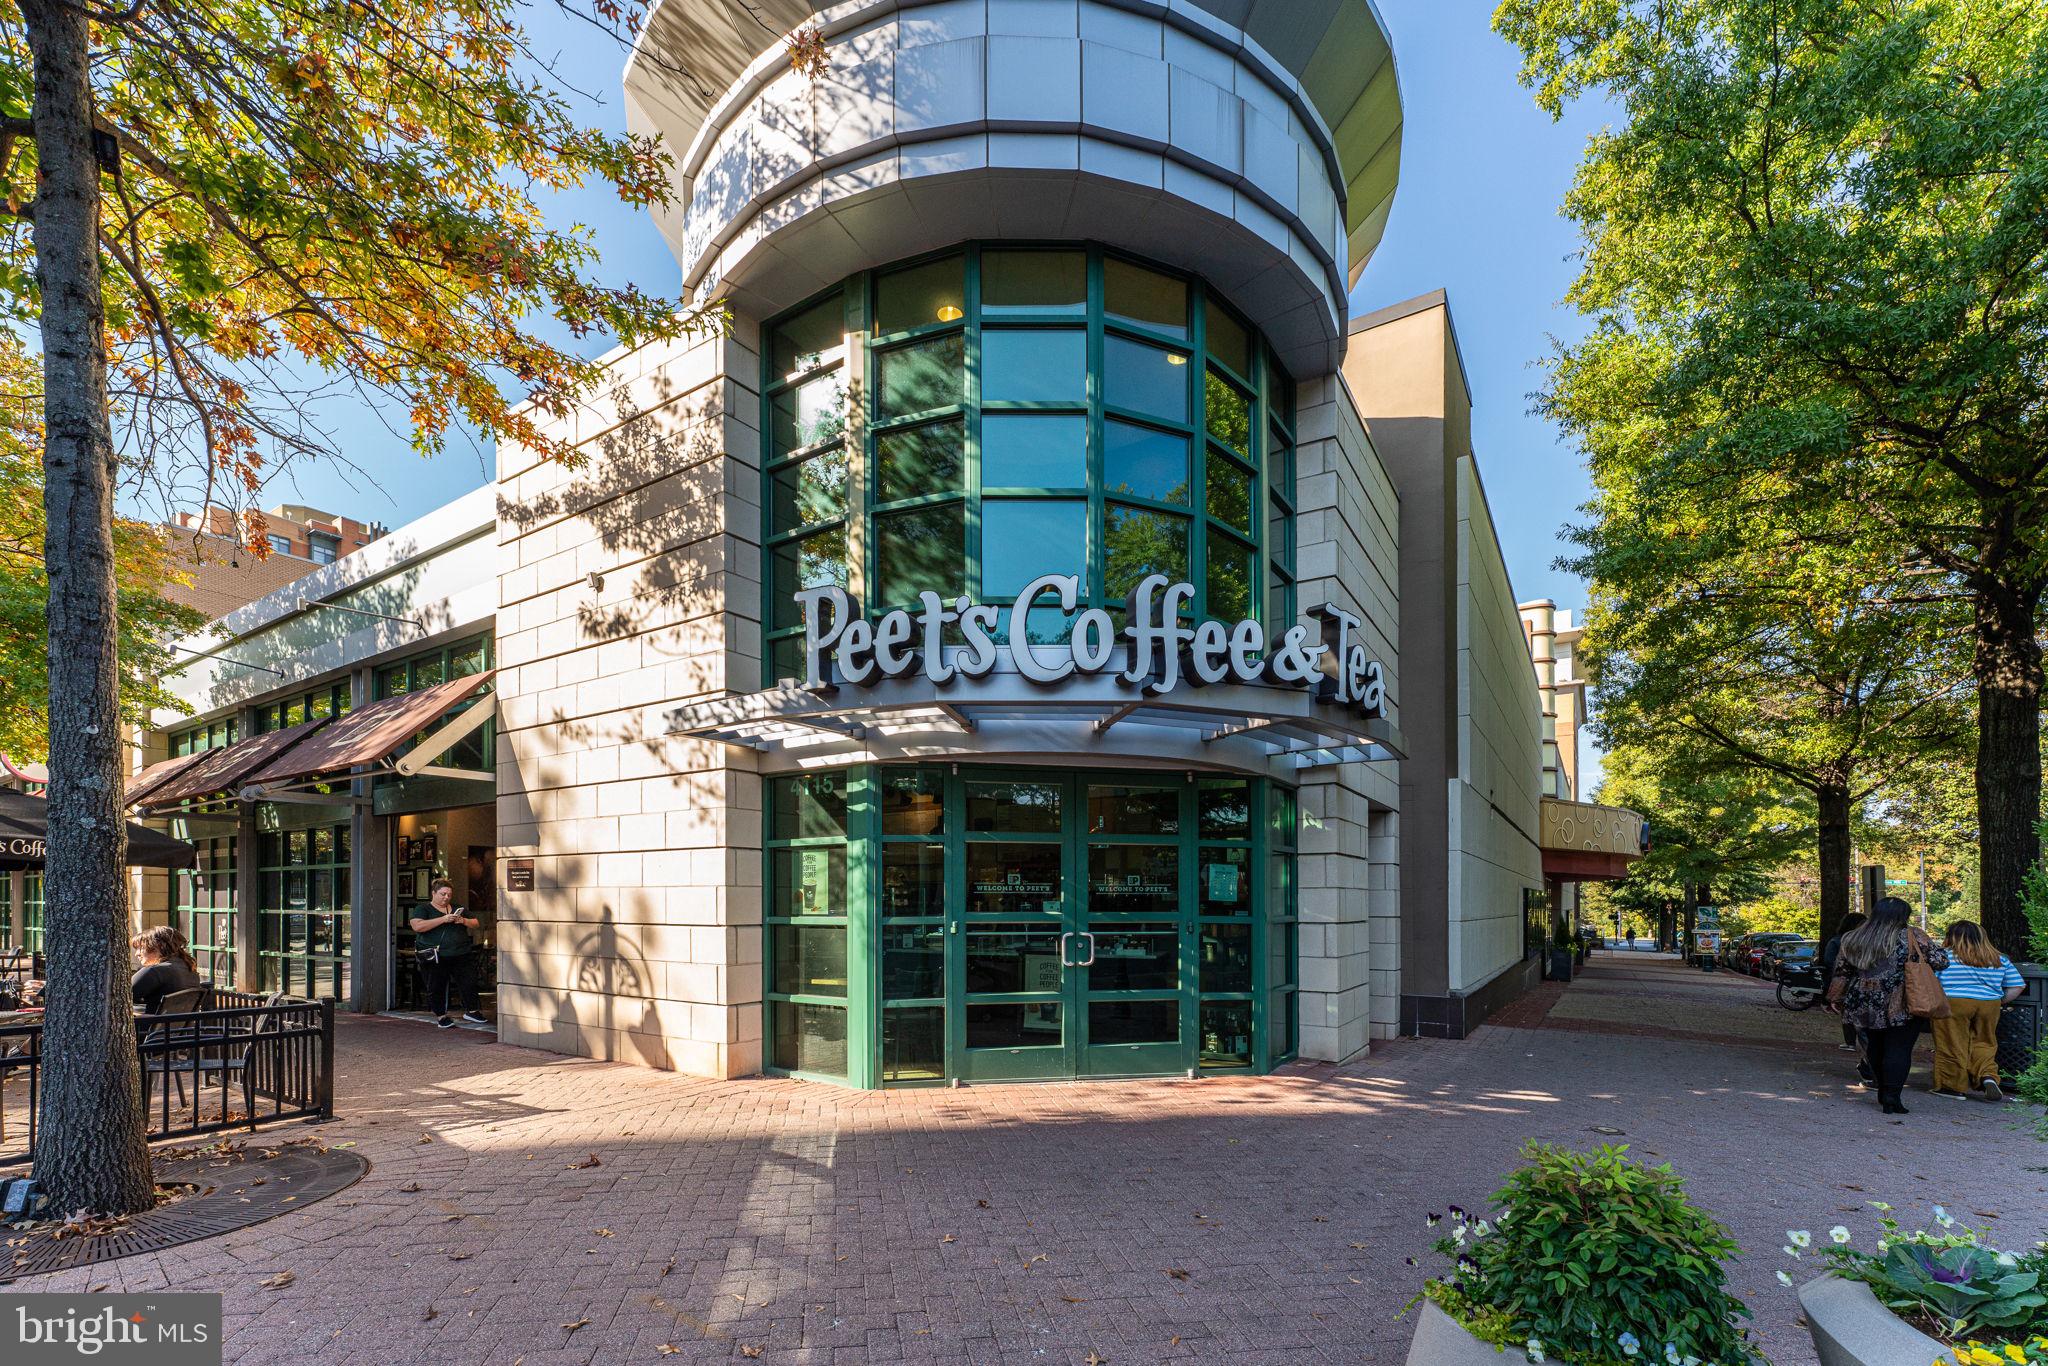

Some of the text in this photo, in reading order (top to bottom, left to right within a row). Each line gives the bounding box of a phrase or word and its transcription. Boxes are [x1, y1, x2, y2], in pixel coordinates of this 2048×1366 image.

[794, 573, 1388, 718] Peet's Coffee & Tea
